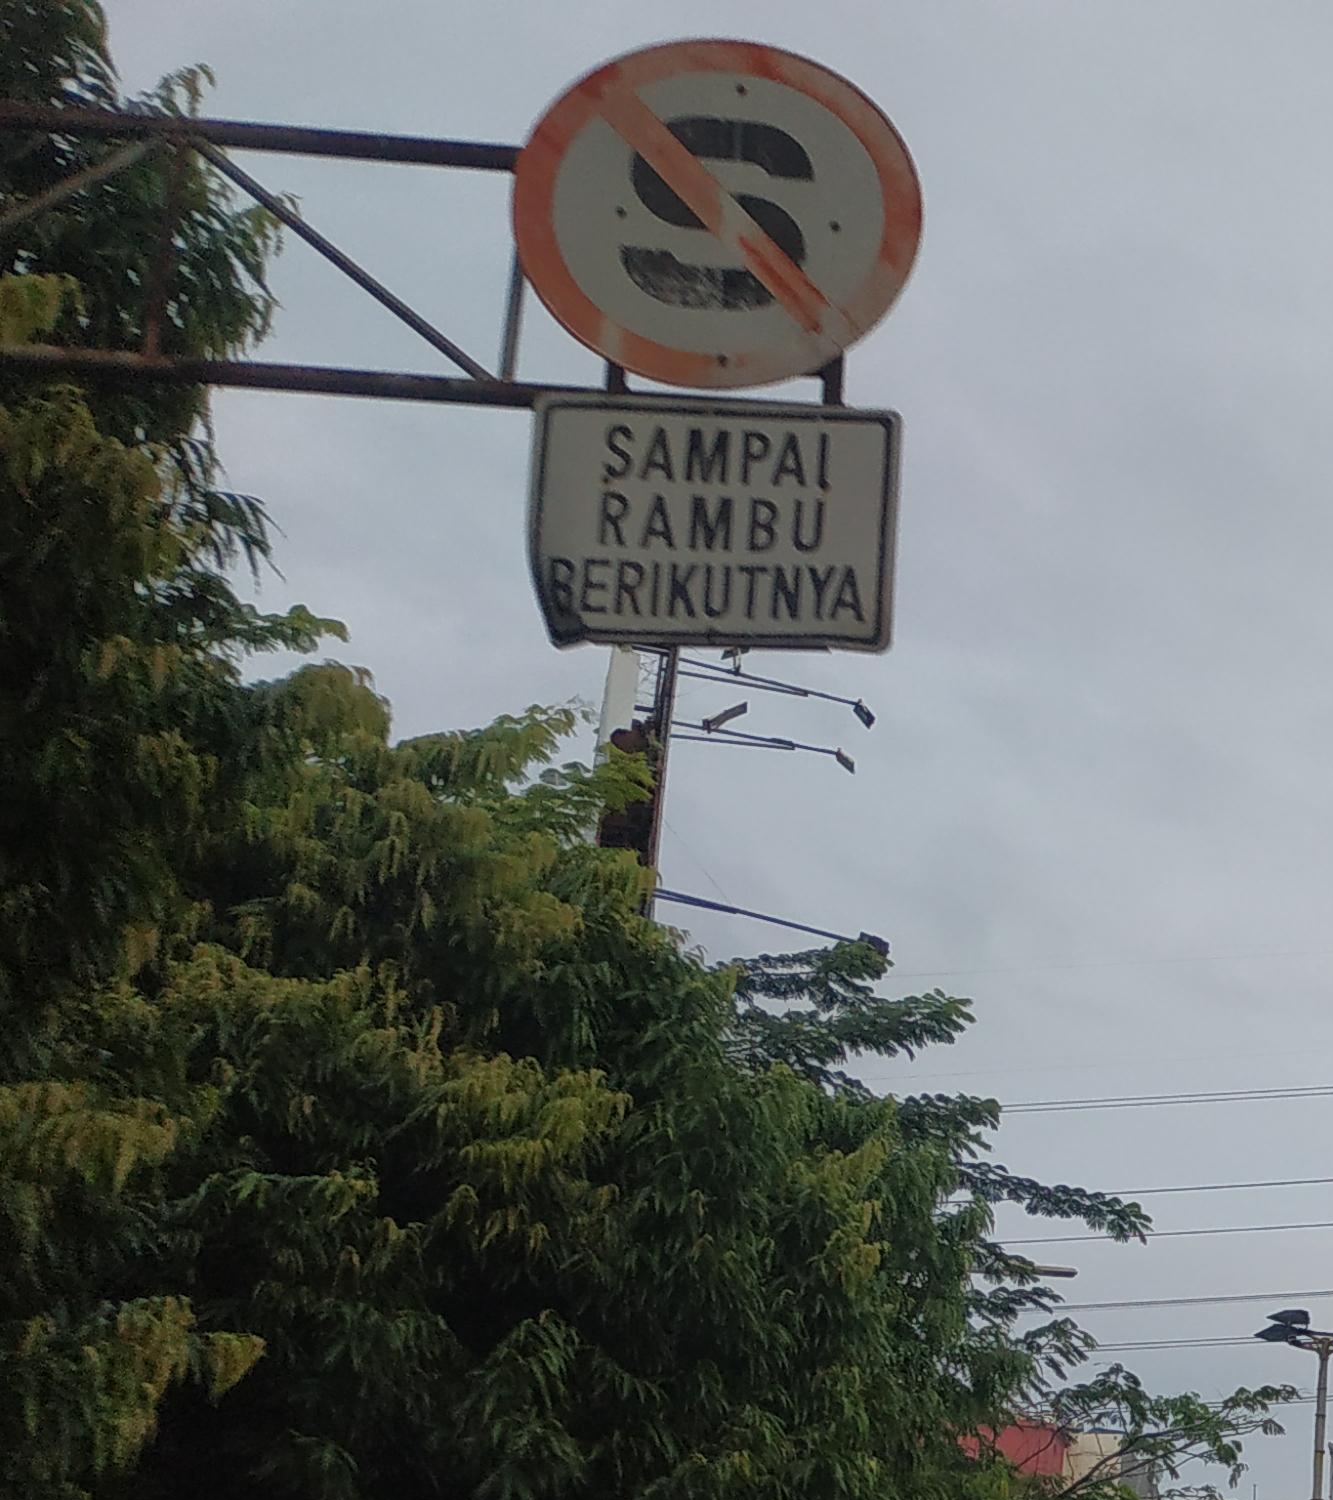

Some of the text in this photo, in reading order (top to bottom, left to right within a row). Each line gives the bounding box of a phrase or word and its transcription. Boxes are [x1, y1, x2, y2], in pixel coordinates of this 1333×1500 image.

[604, 424, 832, 490] SAMPAI
[599, 490, 826, 552] RAMBU
[546, 556, 866, 622] BERIKUTNYA
